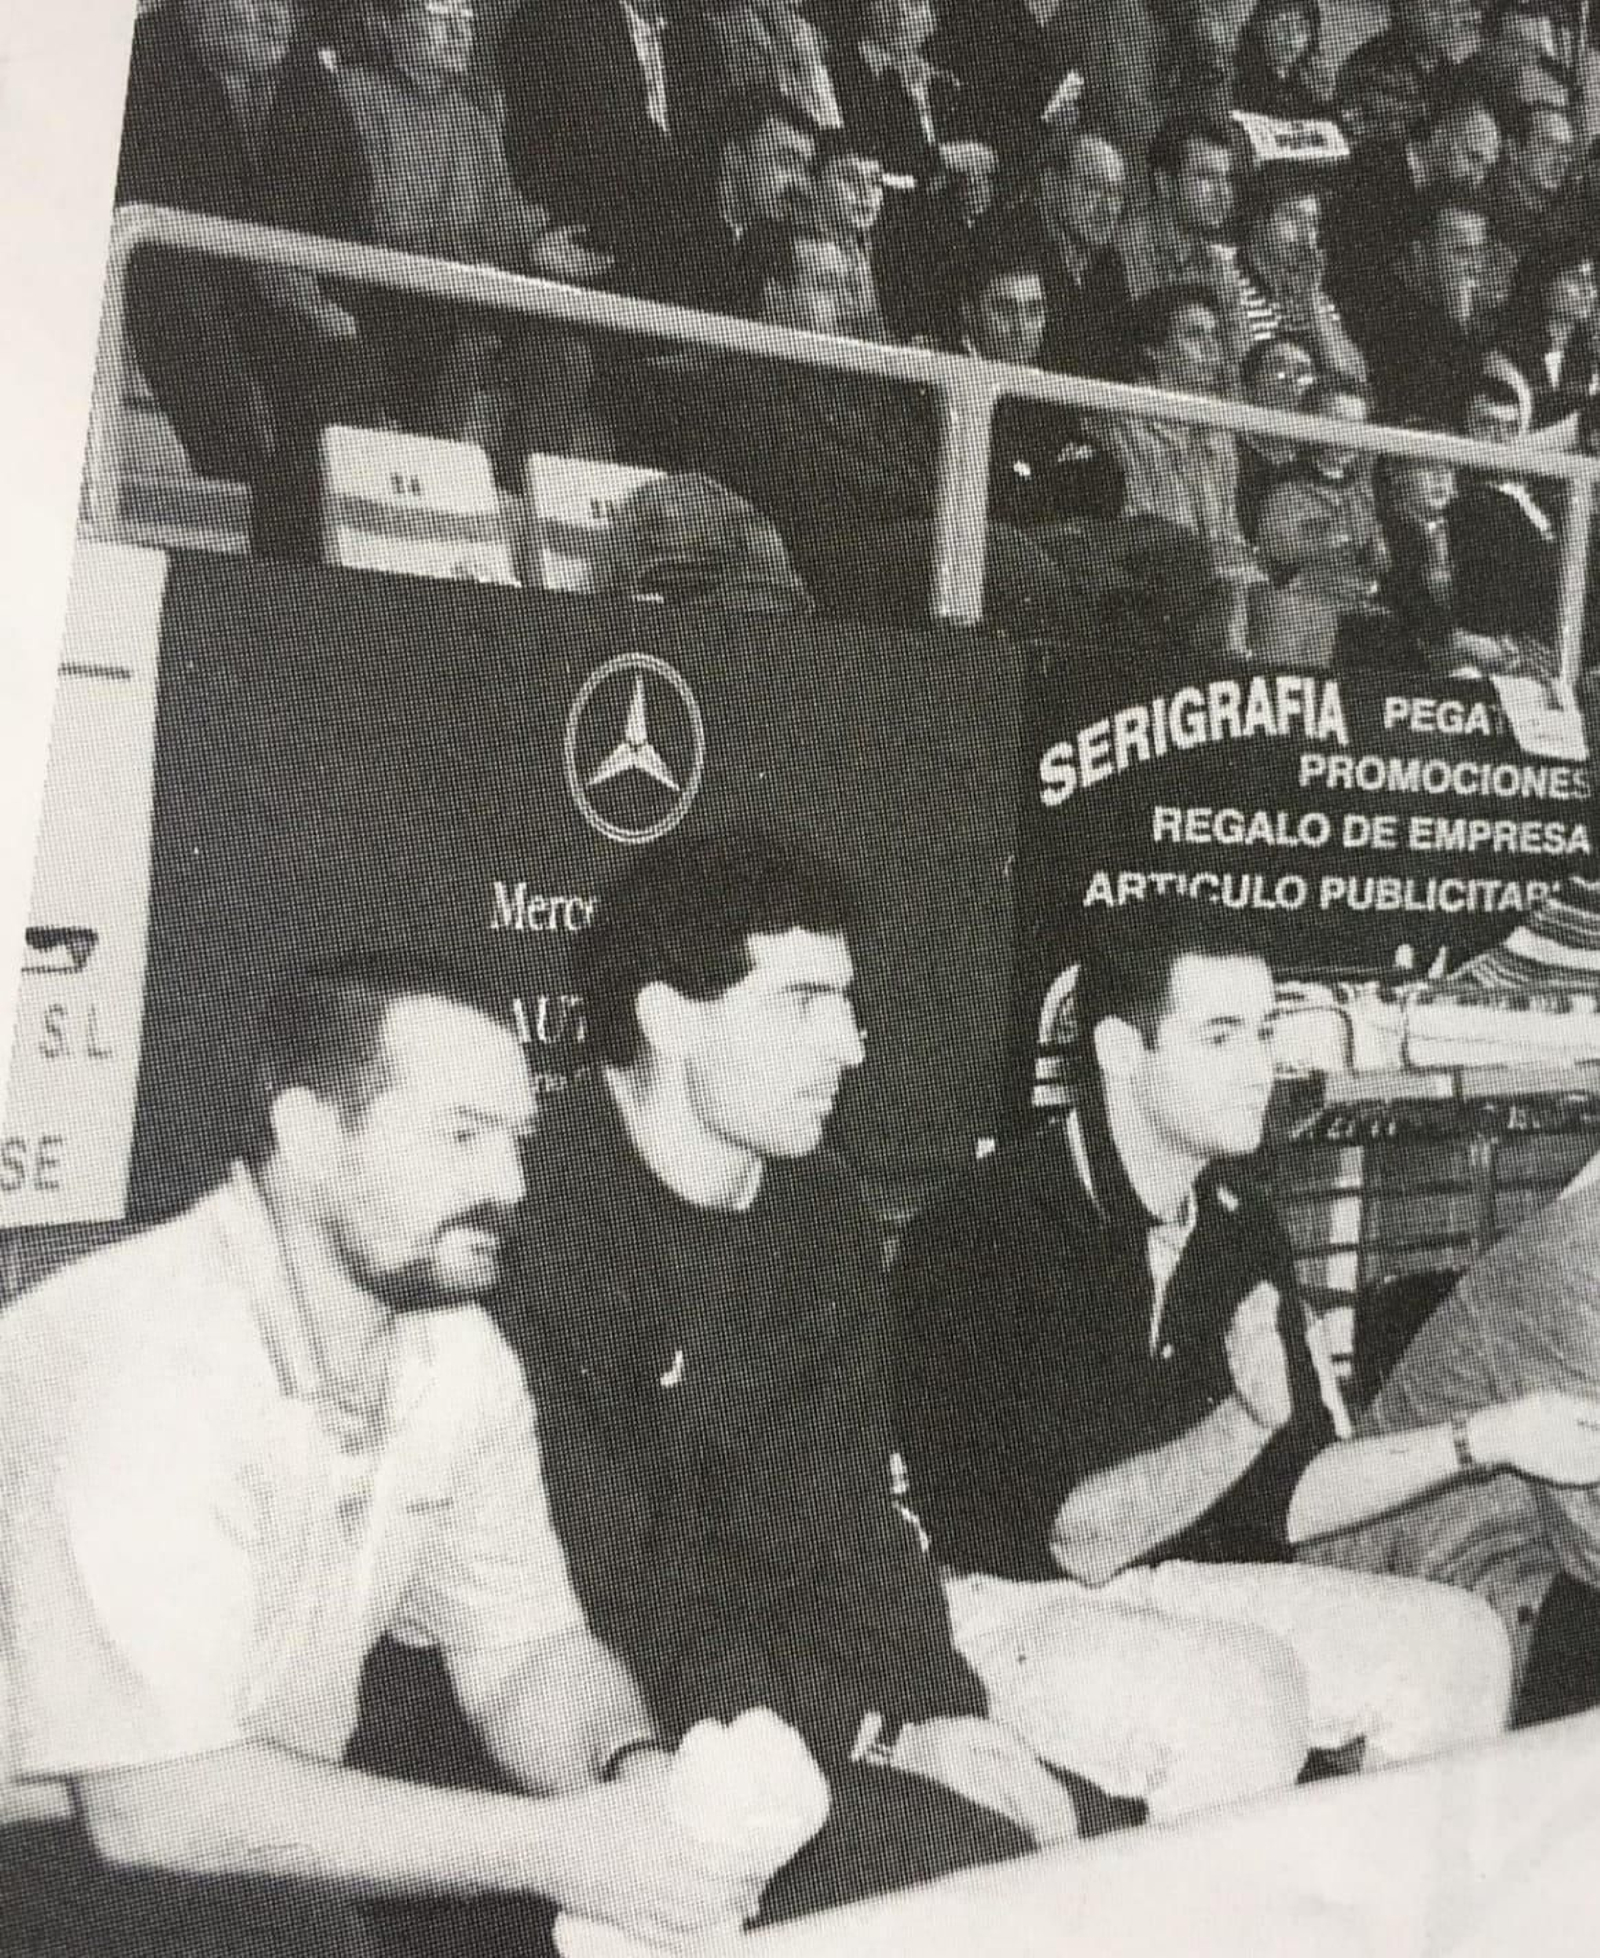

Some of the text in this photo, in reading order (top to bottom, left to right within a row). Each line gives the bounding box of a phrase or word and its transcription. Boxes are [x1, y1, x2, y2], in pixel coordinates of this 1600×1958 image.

[1038, 675, 1350, 808] SERIGRAFIA
[1299, 753, 1591, 799] PROMOCIONES
[1152, 805, 1591, 855] REGALO DE EMPRESA
[1318, 876, 1562, 913] PUBLICITAR
